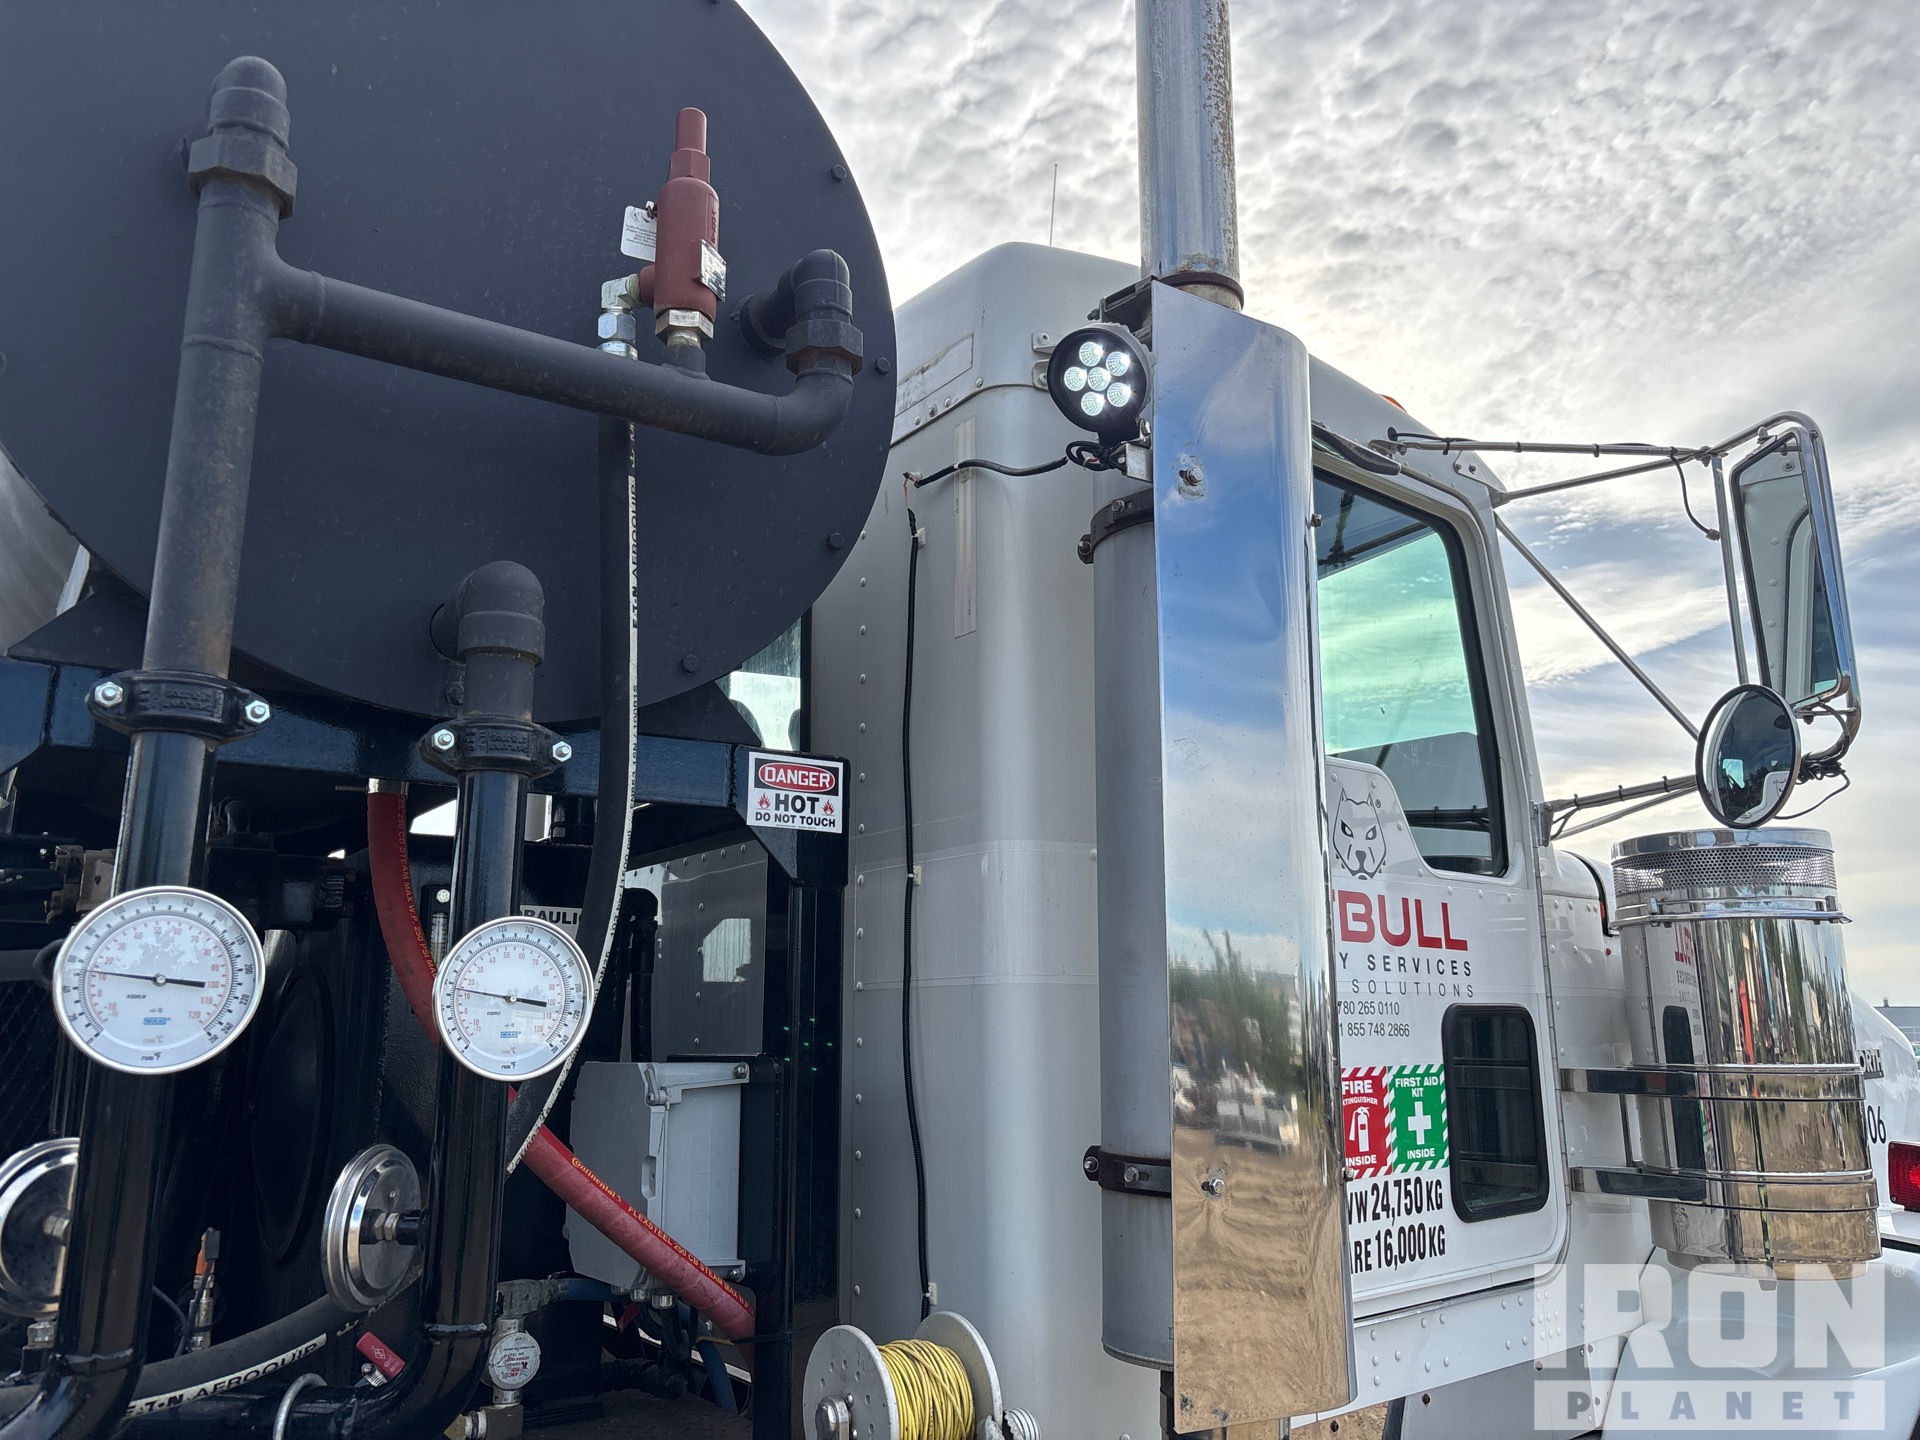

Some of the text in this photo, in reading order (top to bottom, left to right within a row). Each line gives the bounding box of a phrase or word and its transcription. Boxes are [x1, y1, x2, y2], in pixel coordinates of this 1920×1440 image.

[764, 766, 831, 788] DANGER
[775, 793, 819, 814] HOT
[755, 812, 770, 822] DO
[774, 813, 797, 823] NOT
[800, 815, 836, 828] TOUCH
[404, 881, 414, 902] MAX
[414, 926, 424, 942] 250
[1332, 889, 1468, 951] BULL
[1367, 954, 1472, 977] SERVICES
[1352, 979, 1474, 998] SOLUTIONS
[1358, 1001, 1376, 1015] 265
[1378, 1001, 1400, 1015] 0110
[1347, 1022, 1366, 1037] 855
[1368, 1022, 1385, 1037] 748
[1388, 1023, 1410, 1037] 2866
[1859, 1049, 1882, 1072] ORTH
[1342, 1079, 1373, 1095] FIRE
[1395, 1076, 1439, 1087] FIRST AID
[1411, 1088, 1424, 1098] KIT
[1867, 1105, 1887, 1145] 06
[1346, 1154, 1377, 1167] INSIDE
[1407, 1148, 1436, 1160] INSIDE
[1371, 1176, 1423, 1227] 24,750
[1426, 1179, 1443, 1211] KG
[572, 1157, 616, 1198] Continental
[628, 1206, 673, 1246] FLEXSTEEL
[674, 1242, 687, 1256] 250
[700, 1263, 724, 1286] STEAM
[1349, 1222, 1446, 1274] RE 16,000 KG
[194, 1342, 319, 1400] AEROQUIP
